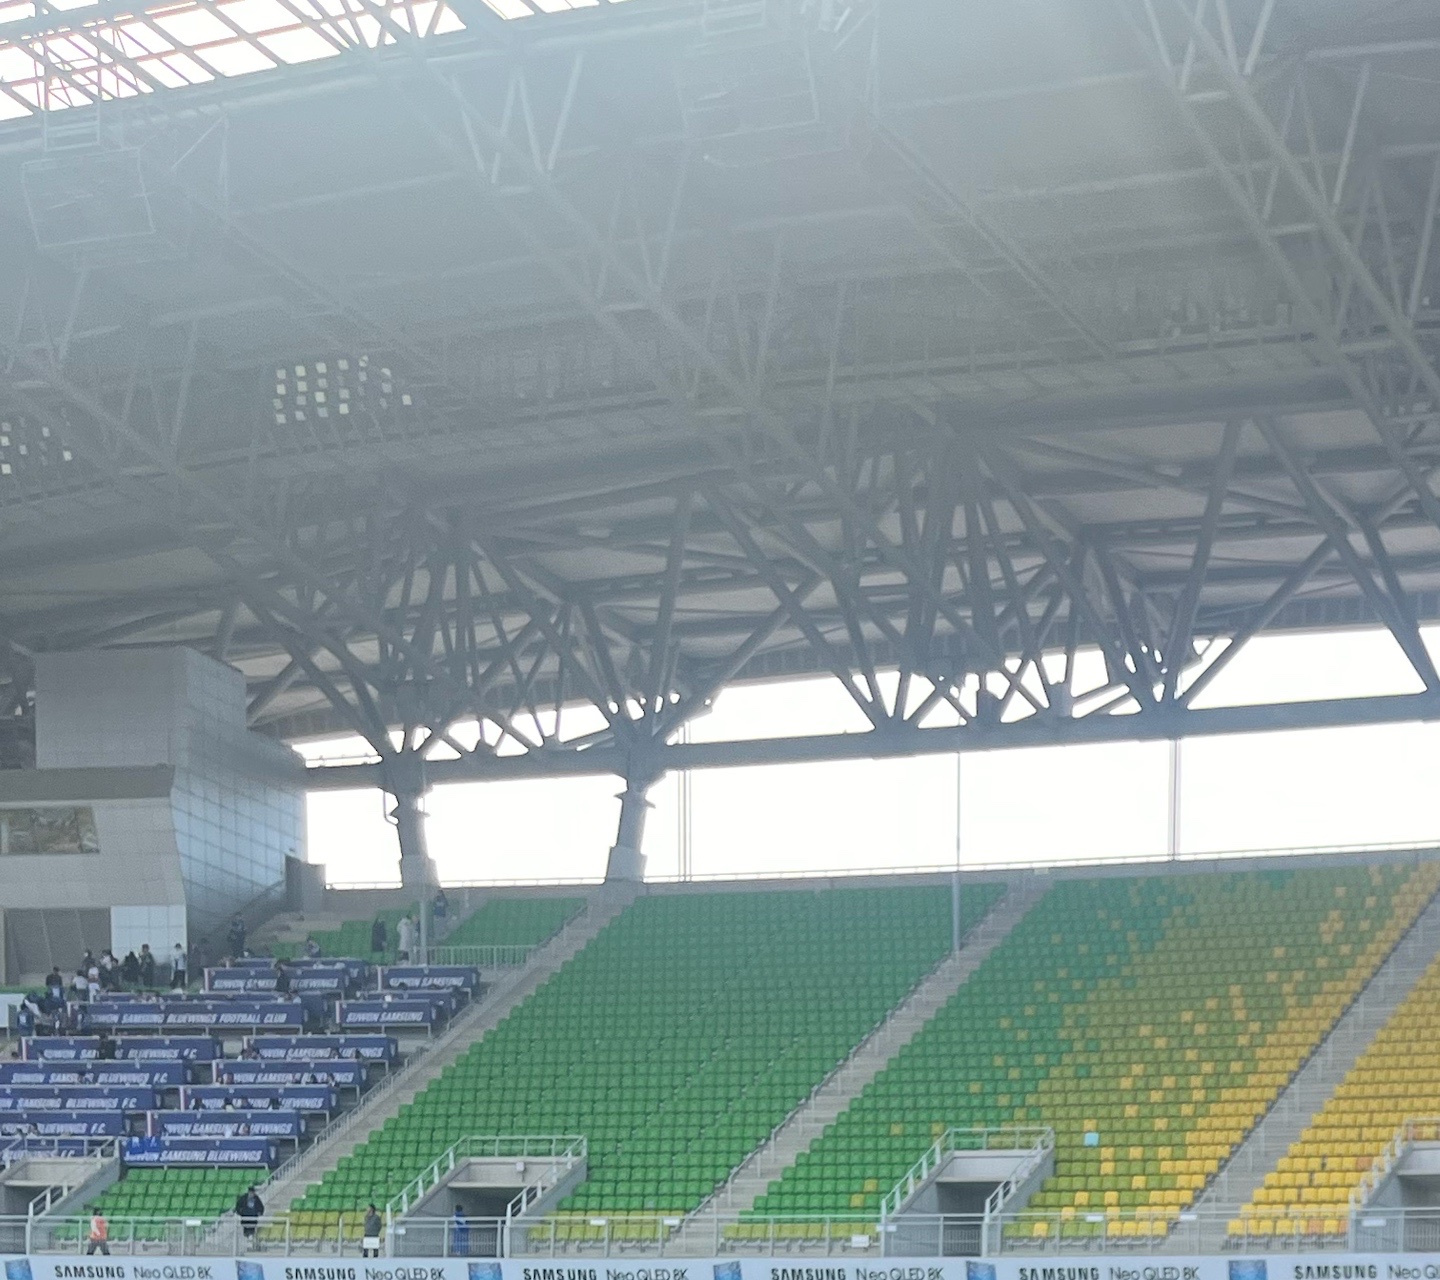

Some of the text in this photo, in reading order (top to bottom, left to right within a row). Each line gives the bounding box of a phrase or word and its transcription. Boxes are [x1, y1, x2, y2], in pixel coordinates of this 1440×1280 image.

[55, 1265, 213, 1280] SAMSUNG Neo QLED 8K
[285, 1267, 446, 1280] SAMSUNG Neo QLED 8K
[1110, 1266, 1141, 1280] Neo
[1143, 1266, 1181, 1280] QLED
[1183, 1266, 1200, 1280] 8K
[1294, 1265, 1378, 1280] SAMSUNG
[1387, 1264, 1422, 1279] Neo
